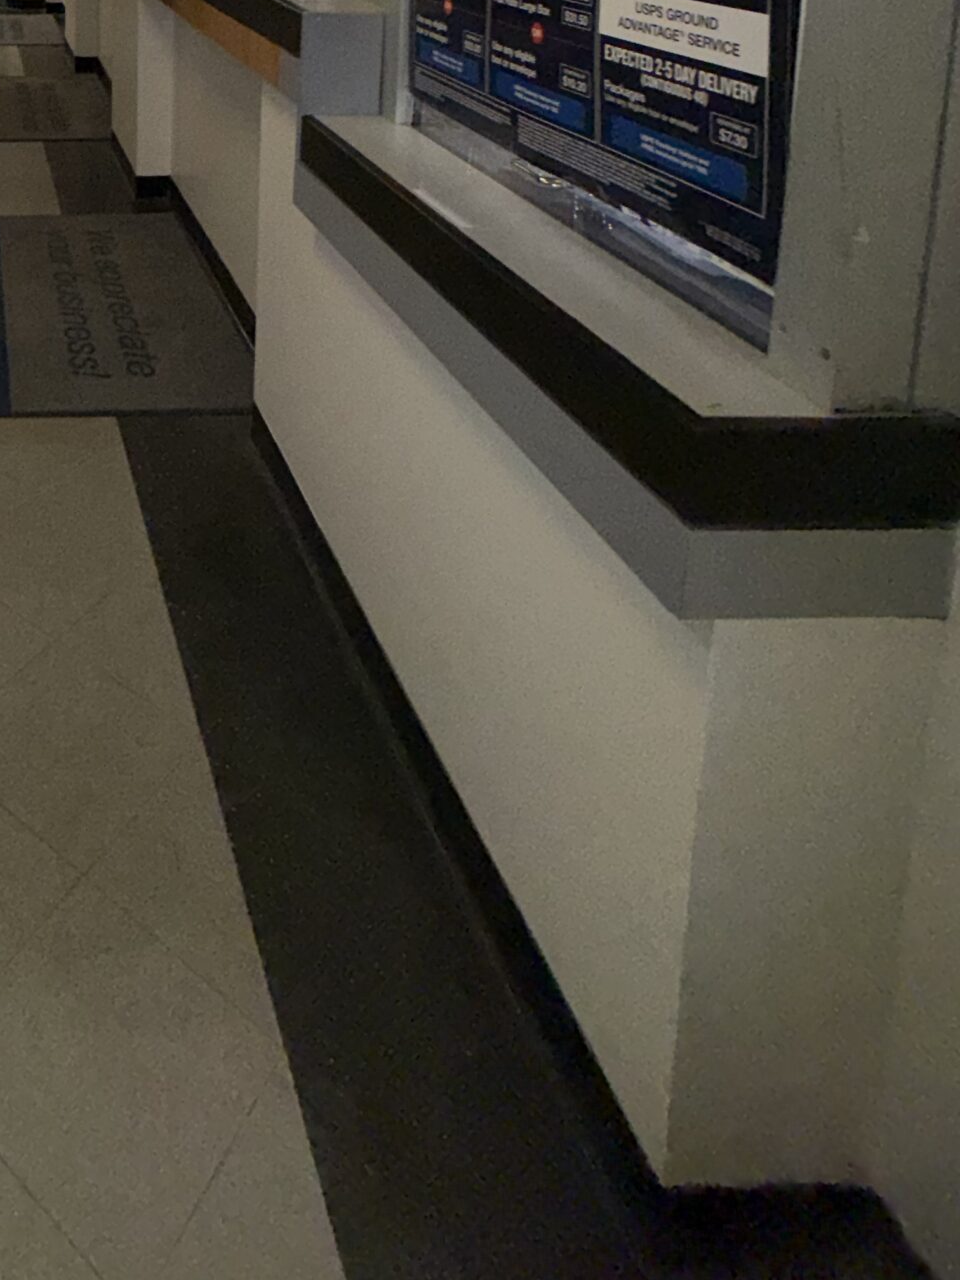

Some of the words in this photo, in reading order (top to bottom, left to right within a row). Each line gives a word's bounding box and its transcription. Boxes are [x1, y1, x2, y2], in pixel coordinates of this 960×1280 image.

[635, 3, 662, 18] USPS
[666, 8, 718, 30] GROUND
[687, 33, 739, 57] SERVICE
[604, 44, 653, 71] EXPECTED
[654, 58, 672, 78] 2-5
[673, 63, 696, 84] DAY
[698, 70, 757, 102] DELIVERY
[603, 79, 645, 102] Packages
[718, 128, 747, 148] $7.30
[53, 269, 112, 381] business!
[92, 257, 156, 379] appreciate
